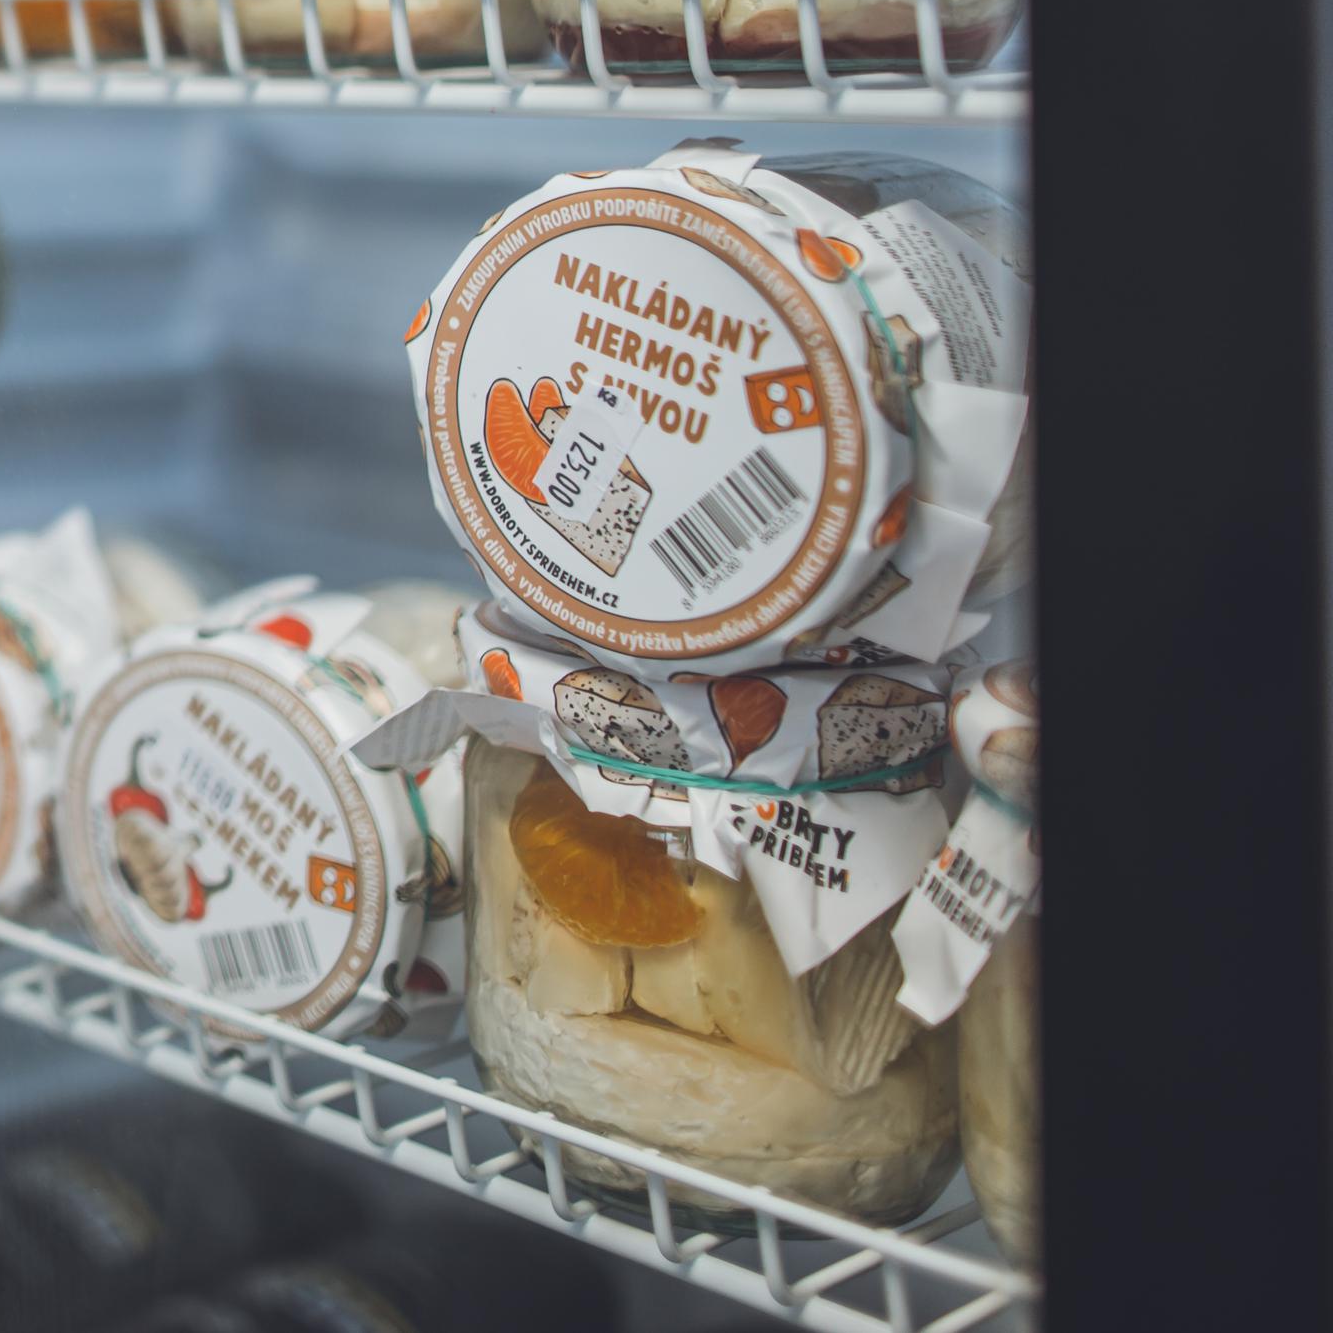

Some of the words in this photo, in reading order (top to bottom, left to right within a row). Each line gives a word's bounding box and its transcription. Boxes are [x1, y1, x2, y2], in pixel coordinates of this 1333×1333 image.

[453, 226, 528, 313] ZAKOUPENÍM
[520, 200, 592, 241] VÝROBKU
[592, 193, 682, 231] PODPOŘÍTE
[554, 252, 773, 361] NAKLÁDANÝ
[432, 336, 457, 414] Vyrobeno
[565, 361, 588, 395] S
[574, 311, 722, 397] HERMOŠ
[435, 418, 447, 429] v
[434, 430, 489, 540] potravinářské
[469, 441, 619, 608] WWW.DOBROTYSPRIBEHEM.CZ
[480, 535, 523, 582] dílně,
[513, 570, 607, 645] vybudované
[607, 629, 618, 642] z
[618, 623, 683, 656] výtěžku
